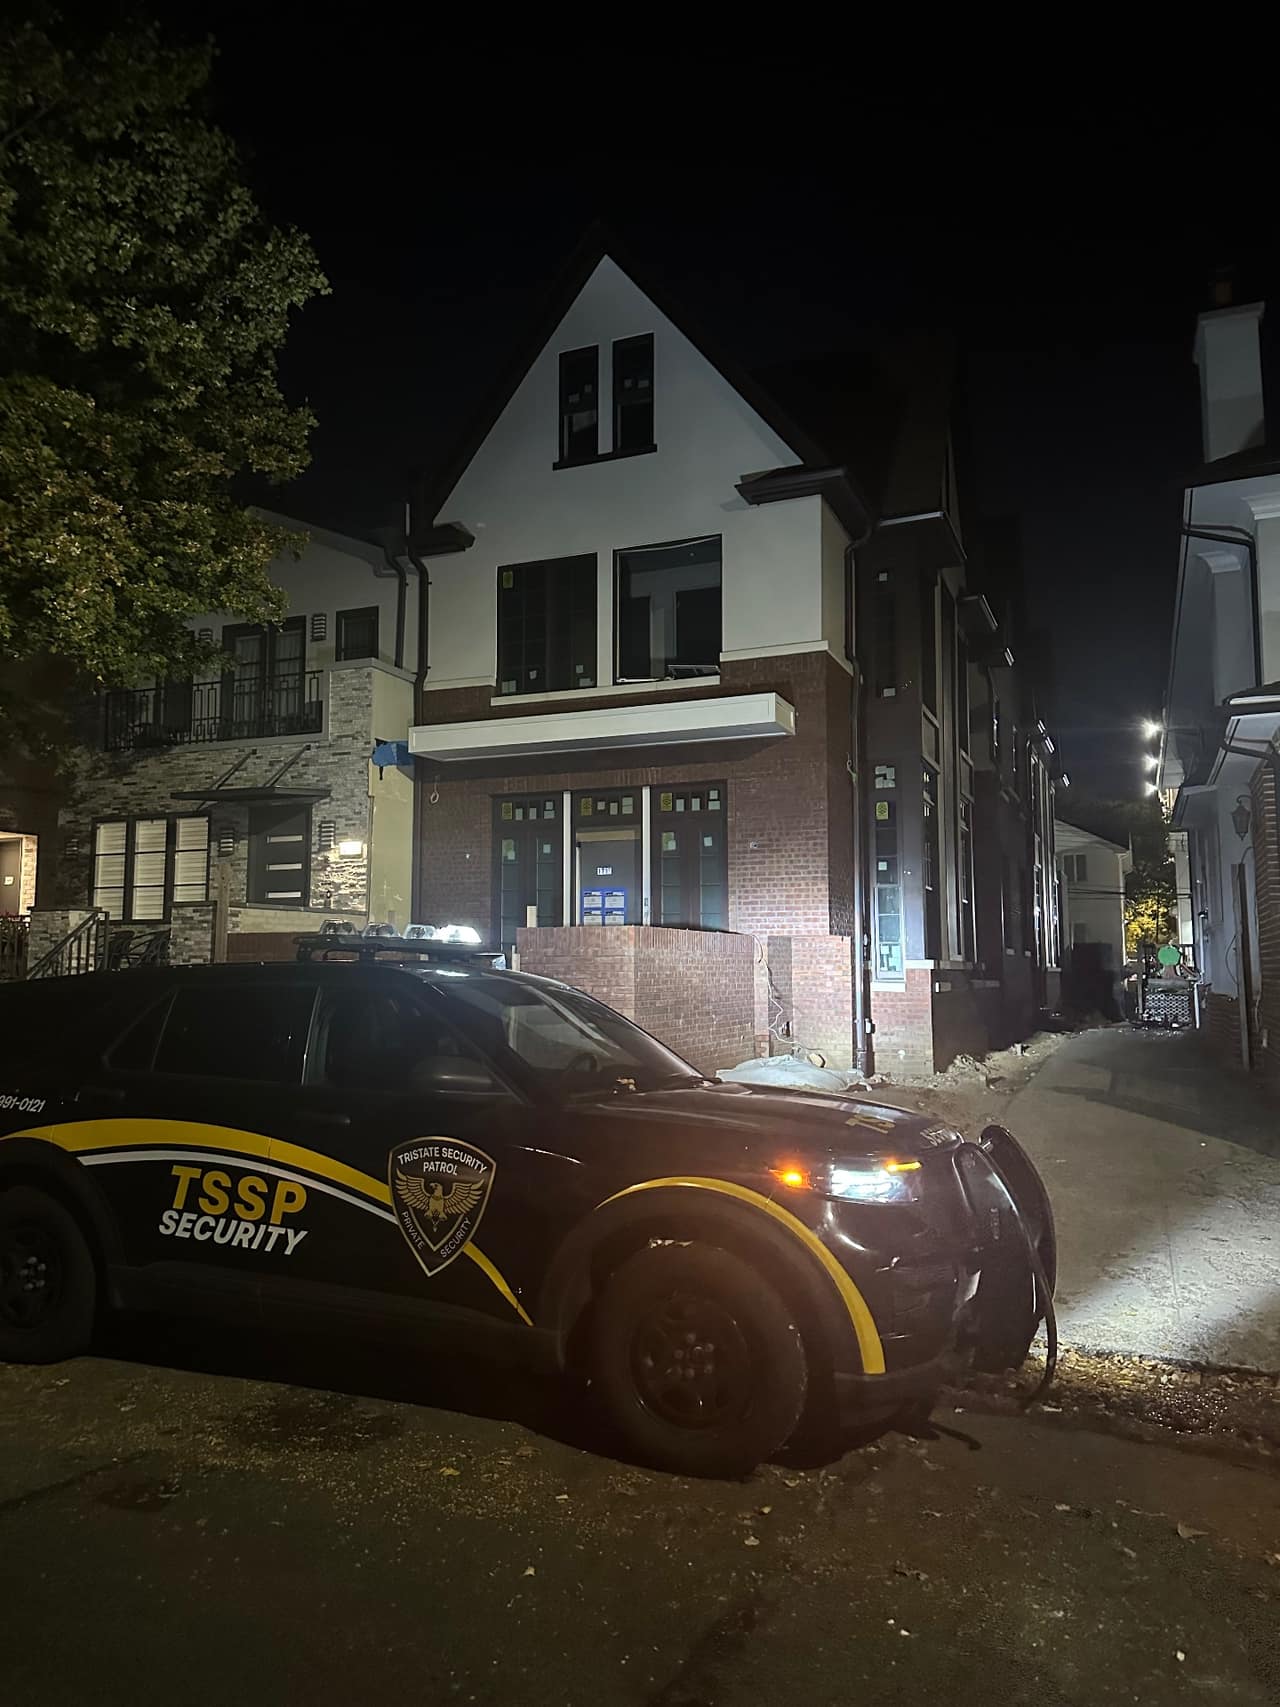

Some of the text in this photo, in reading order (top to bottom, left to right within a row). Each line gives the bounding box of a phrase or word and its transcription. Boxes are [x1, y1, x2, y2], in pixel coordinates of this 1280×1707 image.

[397, 1146, 488, 1174] TRISTATE SECURITY
[423, 1161, 458, 1176] PATROL
[171, 1165, 308, 1225] TSSP
[158, 1209, 309, 1256] SECURITY
[401, 1210, 425, 1250] PRIVATE
[440, 1217, 472, 1258] SECURITY
